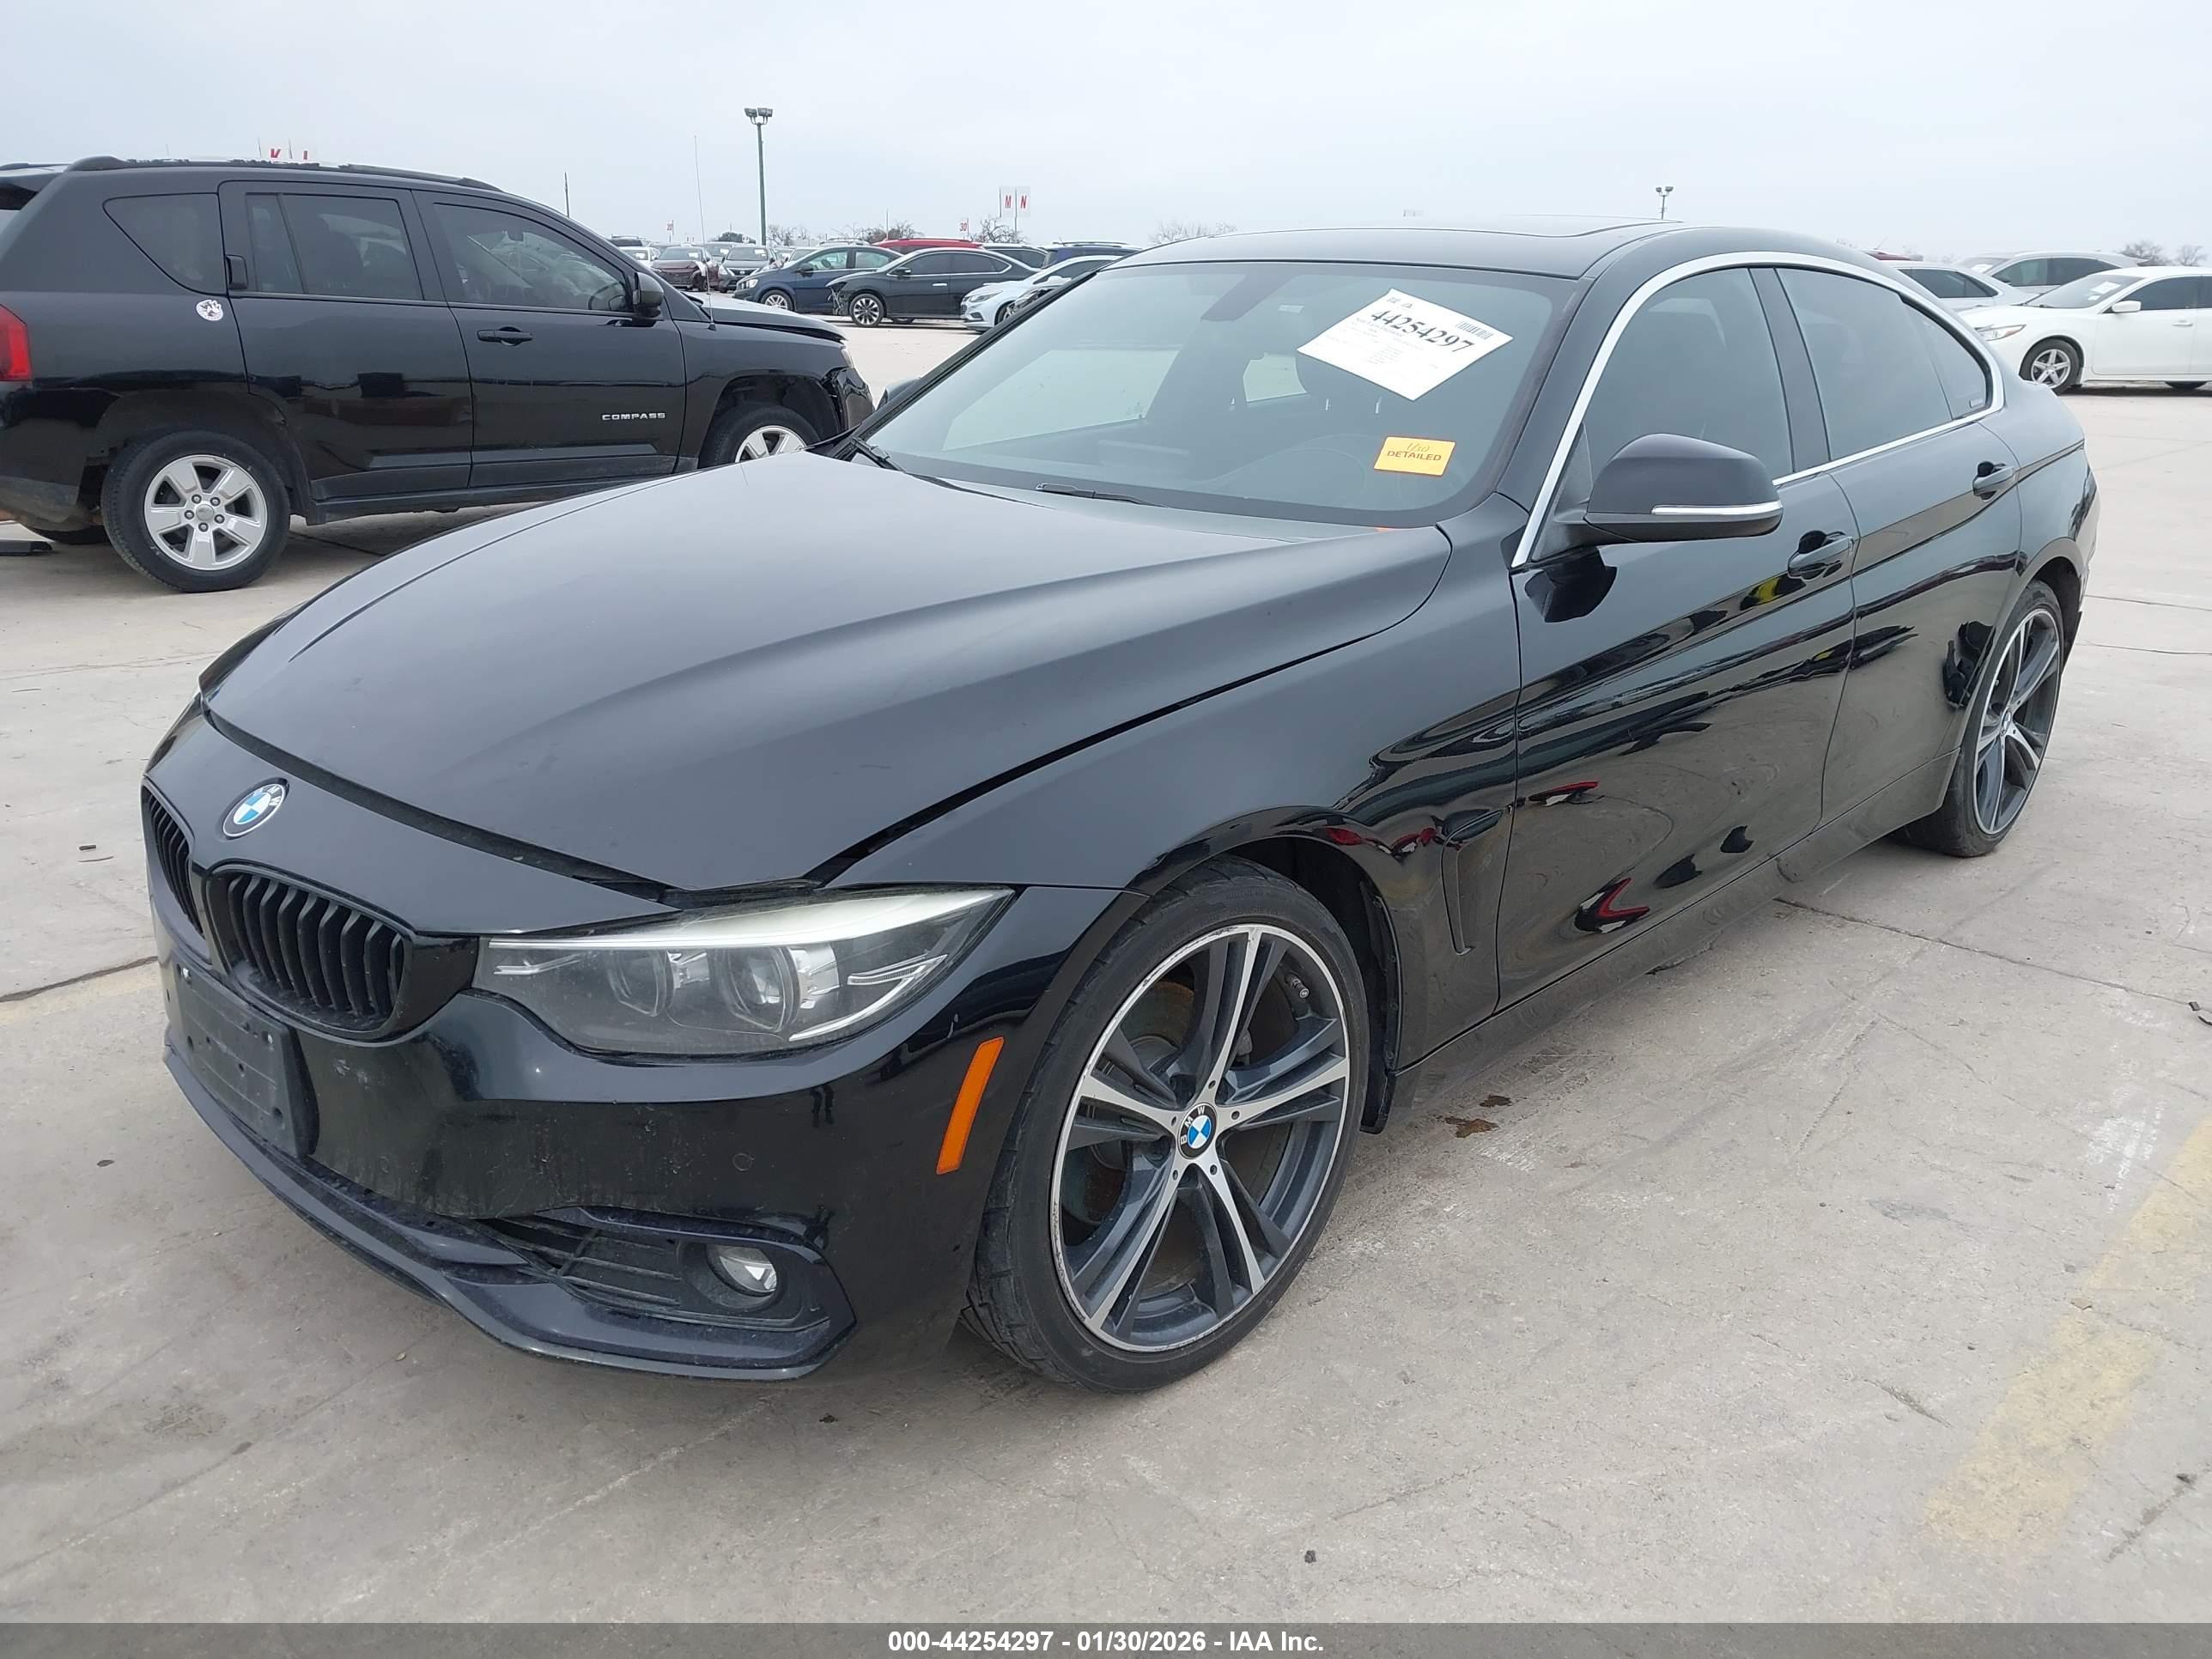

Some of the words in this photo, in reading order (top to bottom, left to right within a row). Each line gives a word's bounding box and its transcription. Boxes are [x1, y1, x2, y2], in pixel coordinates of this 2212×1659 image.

[1005, 194, 1012, 209] M
[1020, 194, 1027, 209] N
[1370, 310, 1475, 352] 44254297
[601, 412, 665, 421] COMPASS
[1387, 450, 1442, 461] DETAILED
[1180, 1105, 1206, 1146] BMW
